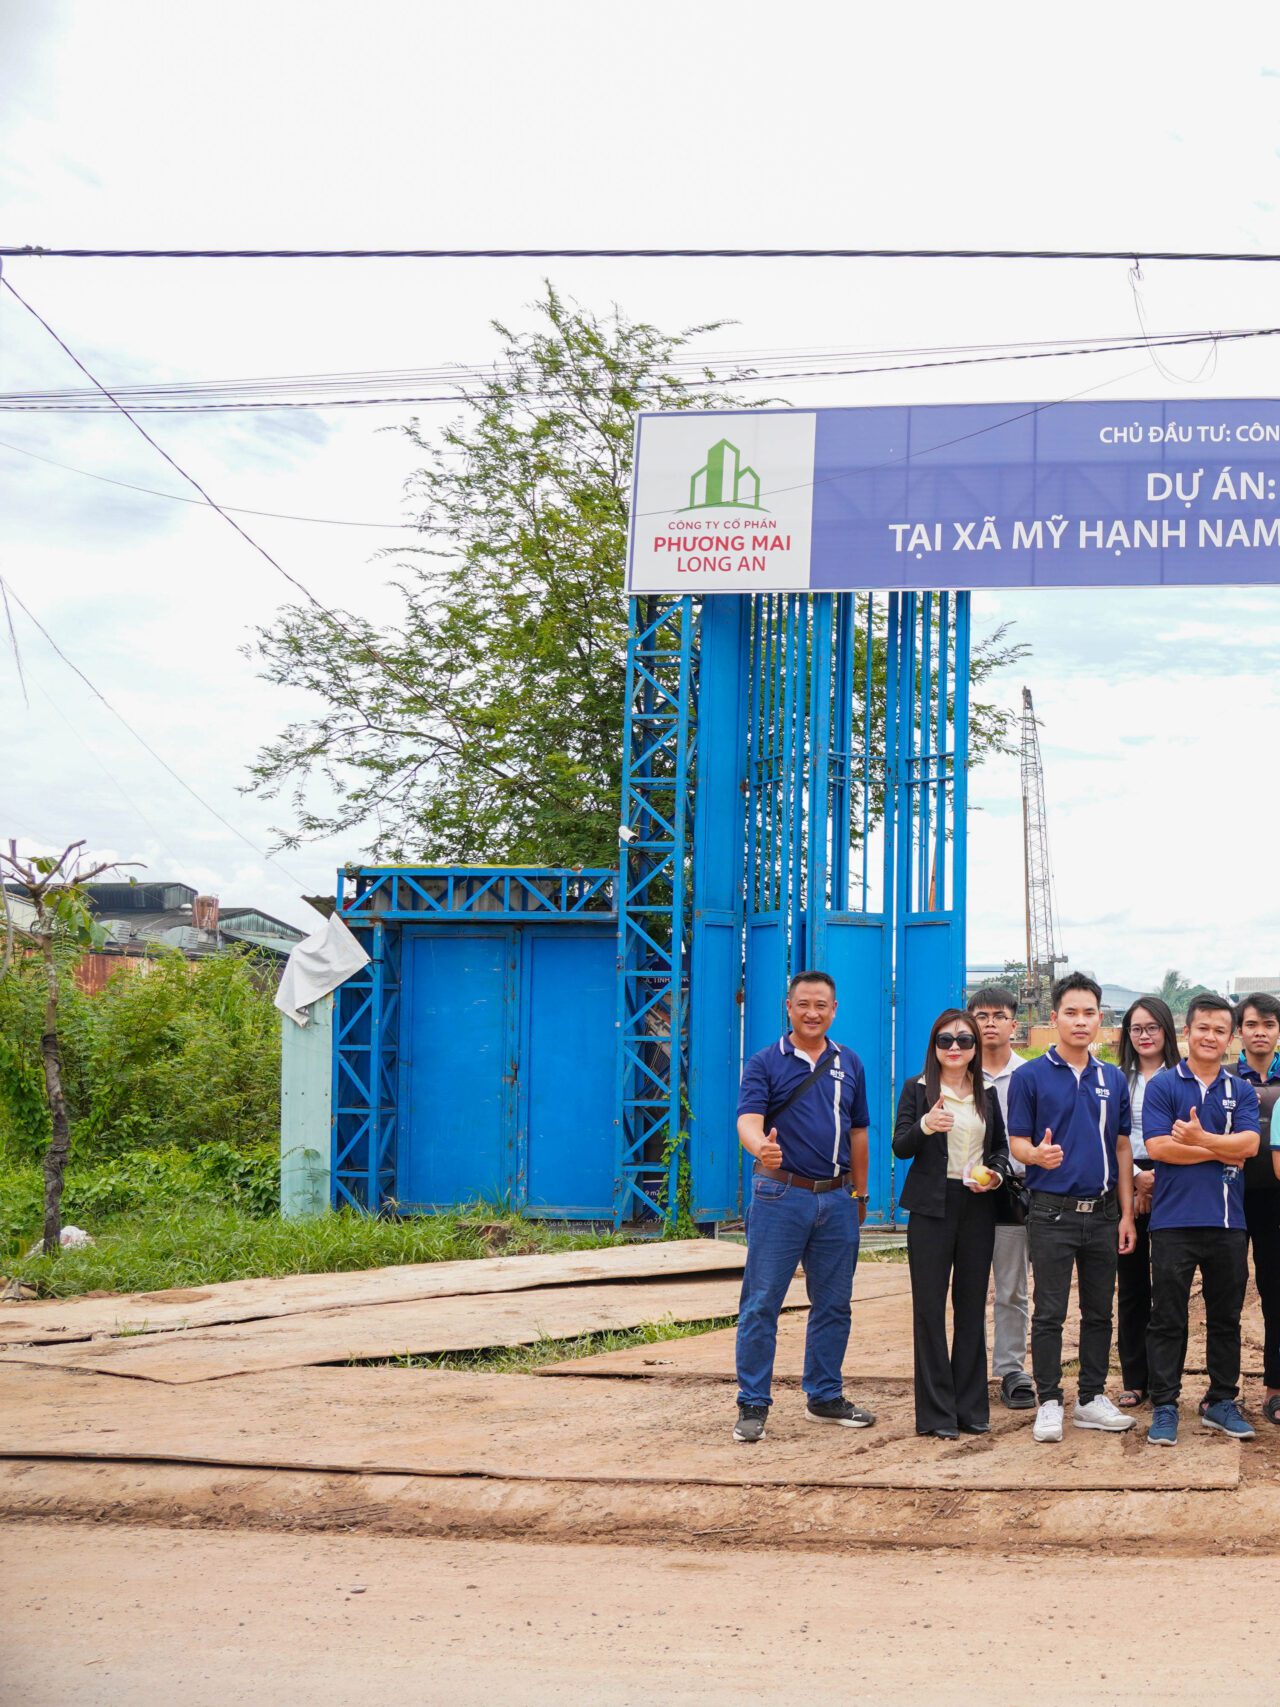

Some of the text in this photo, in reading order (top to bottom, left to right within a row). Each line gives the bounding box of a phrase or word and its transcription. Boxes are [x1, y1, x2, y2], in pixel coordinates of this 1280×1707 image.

[1099, 421, 1143, 443] CHỦ
[1148, 421, 1193, 443] ĐẦU
[1197, 423, 1231, 442] TƯ:
[1147, 468, 1204, 508] DỰ
[1211, 466, 1276, 500] ÁN:
[668, 519, 702, 530] CÔNG
[706, 520, 720, 529] TY
[653, 534, 792, 553] PHƯƠNG MAI
[888, 523, 942, 560] TẠI
[952, 515, 1002, 551] XÃ
[1011, 514, 1069, 550] MỸ
[1079, 519, 1190, 557] HẠNH
[677, 555, 767, 573] LONG AN
[1222, 1099, 1236, 1107] BMS
